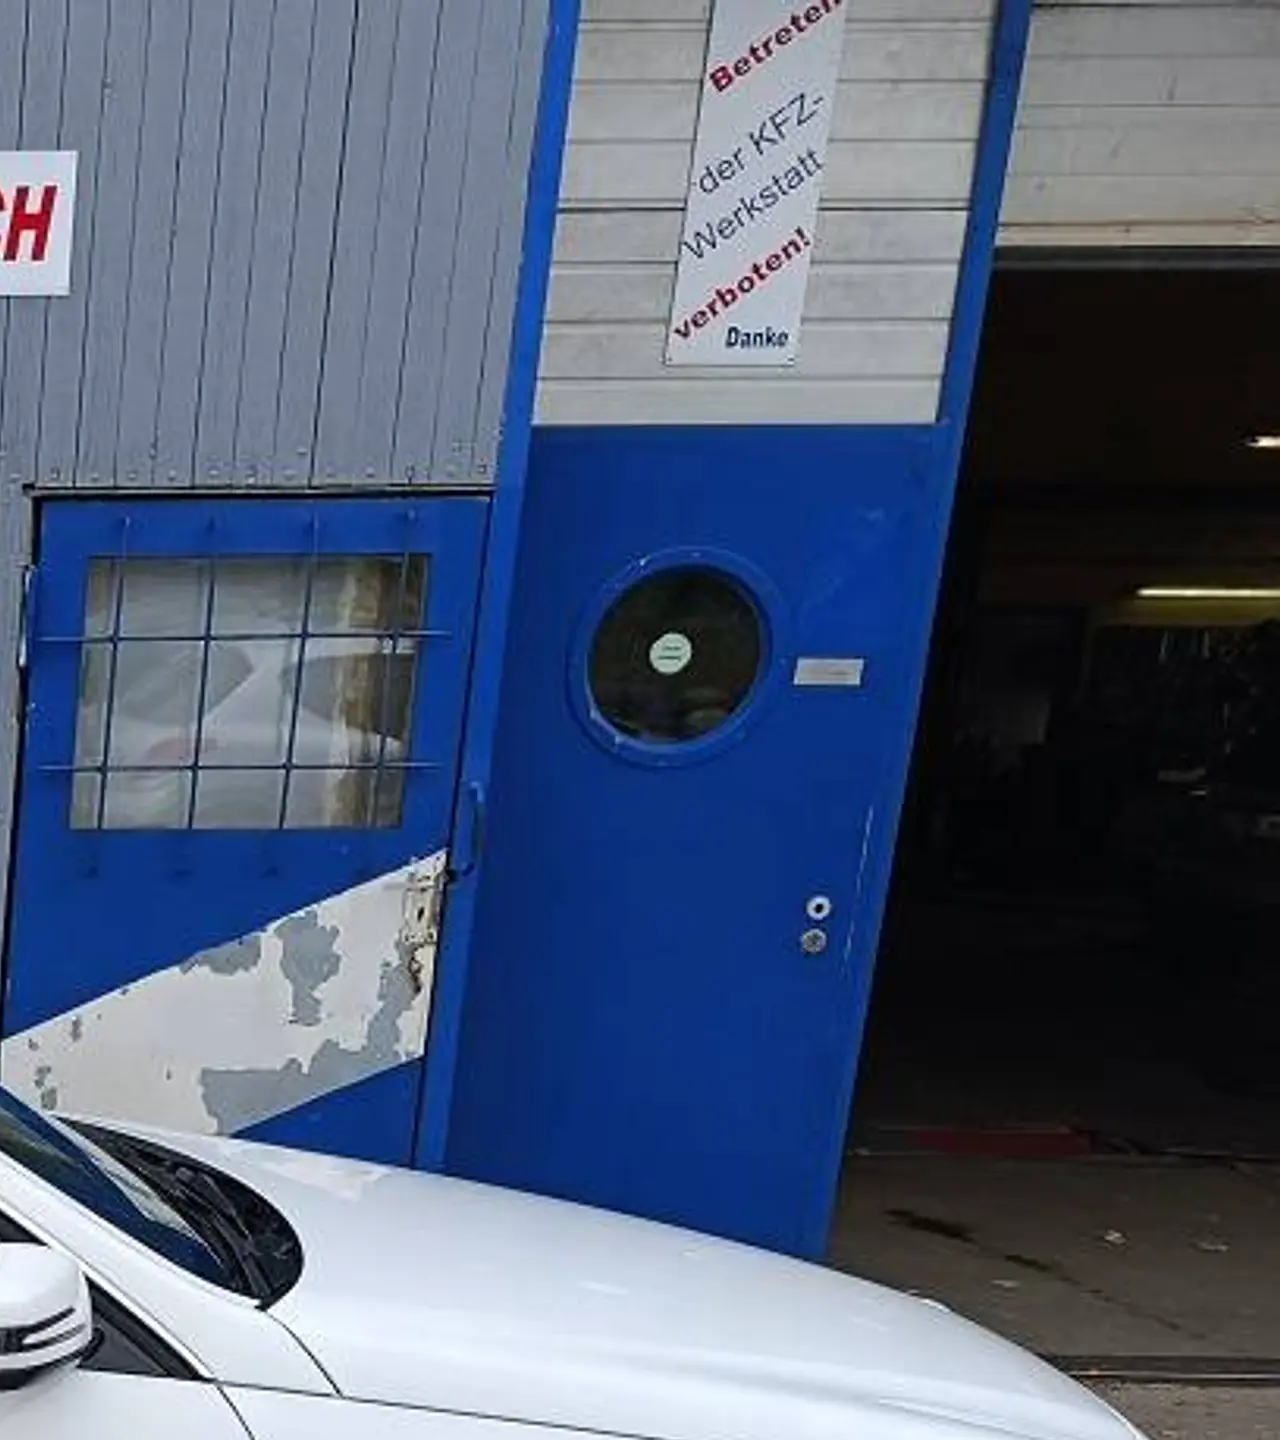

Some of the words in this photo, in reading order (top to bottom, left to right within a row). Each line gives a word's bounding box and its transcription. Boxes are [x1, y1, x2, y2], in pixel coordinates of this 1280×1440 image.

[700, 148, 744, 194] der
[749, 93, 825, 155] KFZ-
[681, 149, 825, 259] Werkstatt
[674, 227, 811, 340] verboten!
[726, 326, 789, 348] Danke
